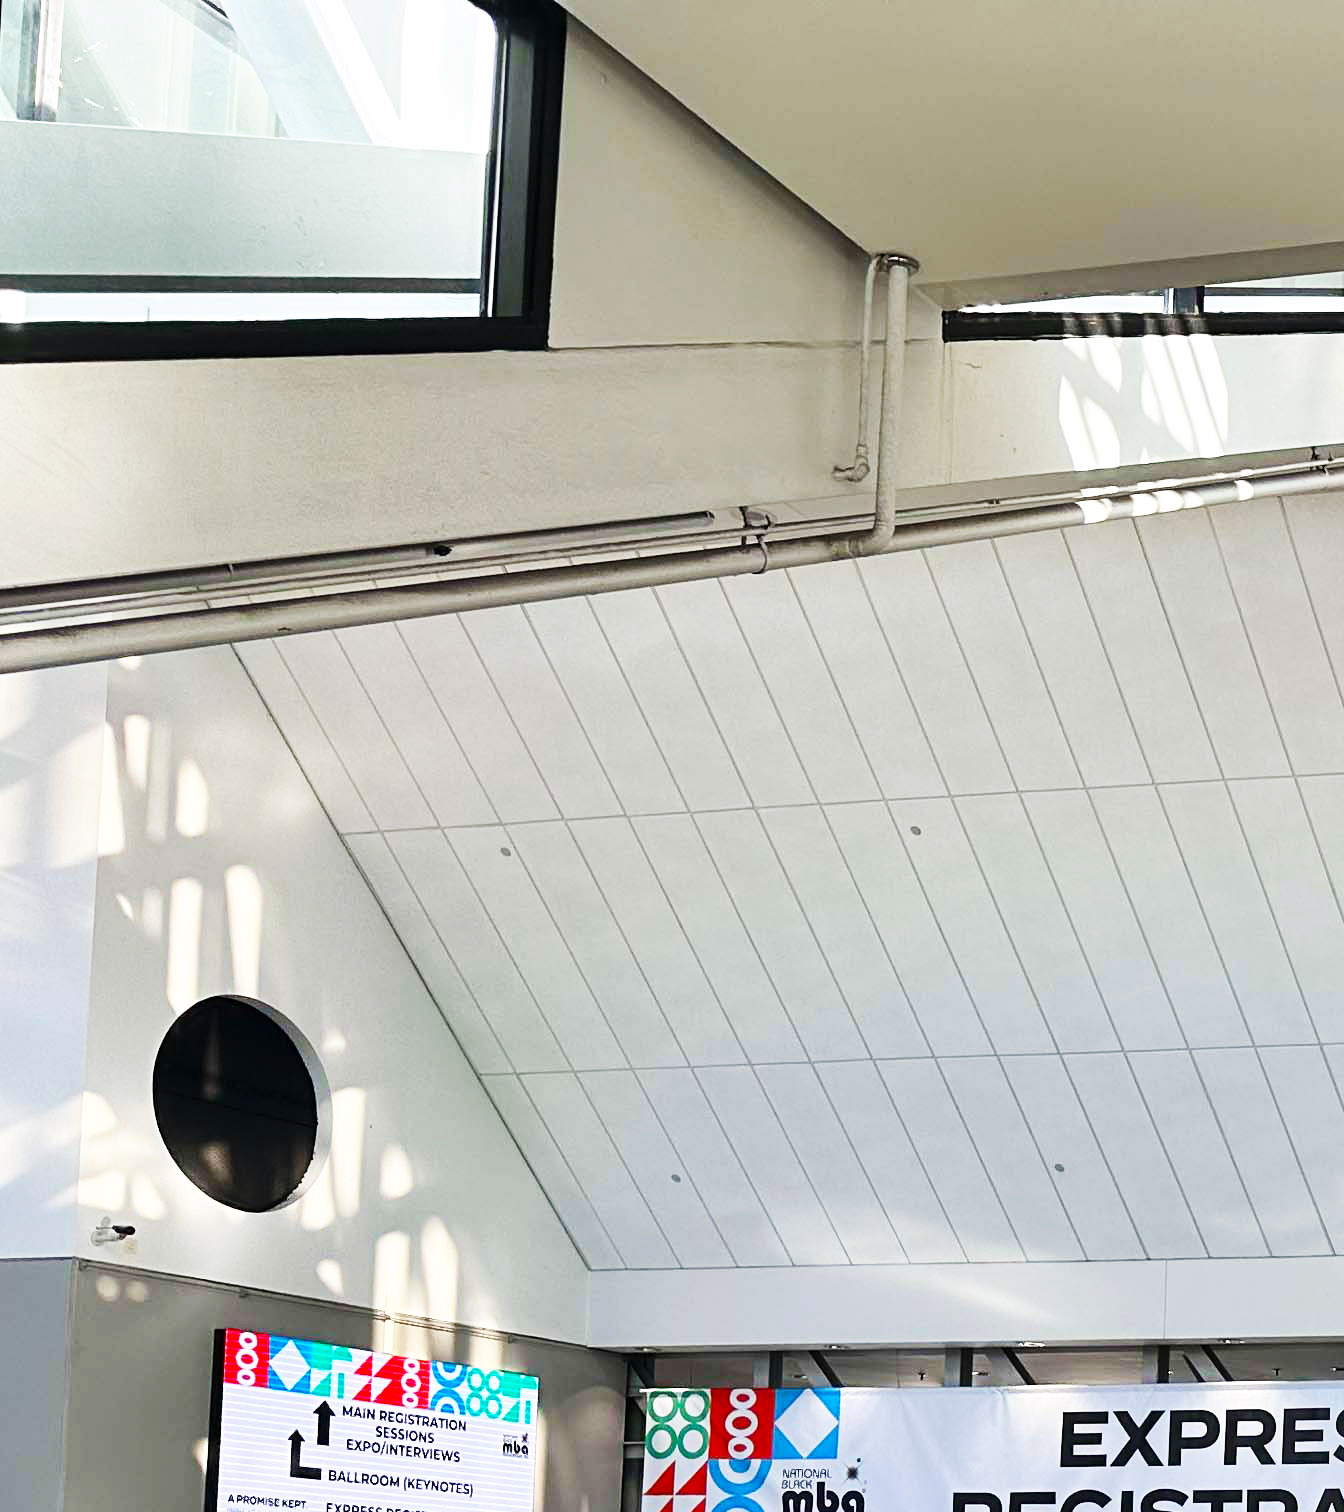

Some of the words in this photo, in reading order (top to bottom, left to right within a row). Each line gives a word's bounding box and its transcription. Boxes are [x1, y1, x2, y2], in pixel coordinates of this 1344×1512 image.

[342, 1405, 375, 1421] MAIN
[379, 1410, 467, 1431] REGISTRATION
[375, 1426, 435, 1444] SESSIONS
[346, 1439, 461, 1462] EXPO/INTERVIEWS
[782, 1468, 832, 1479] NATIONAL
[328, 1470, 400, 1487] BALLROOM
[403, 1477, 474, 1498] (KEYNOTES)
[781, 1479, 813, 1489] BLACK
[227, 1494, 234, 1503] A
[236, 1495, 280, 1507] PROMISE
